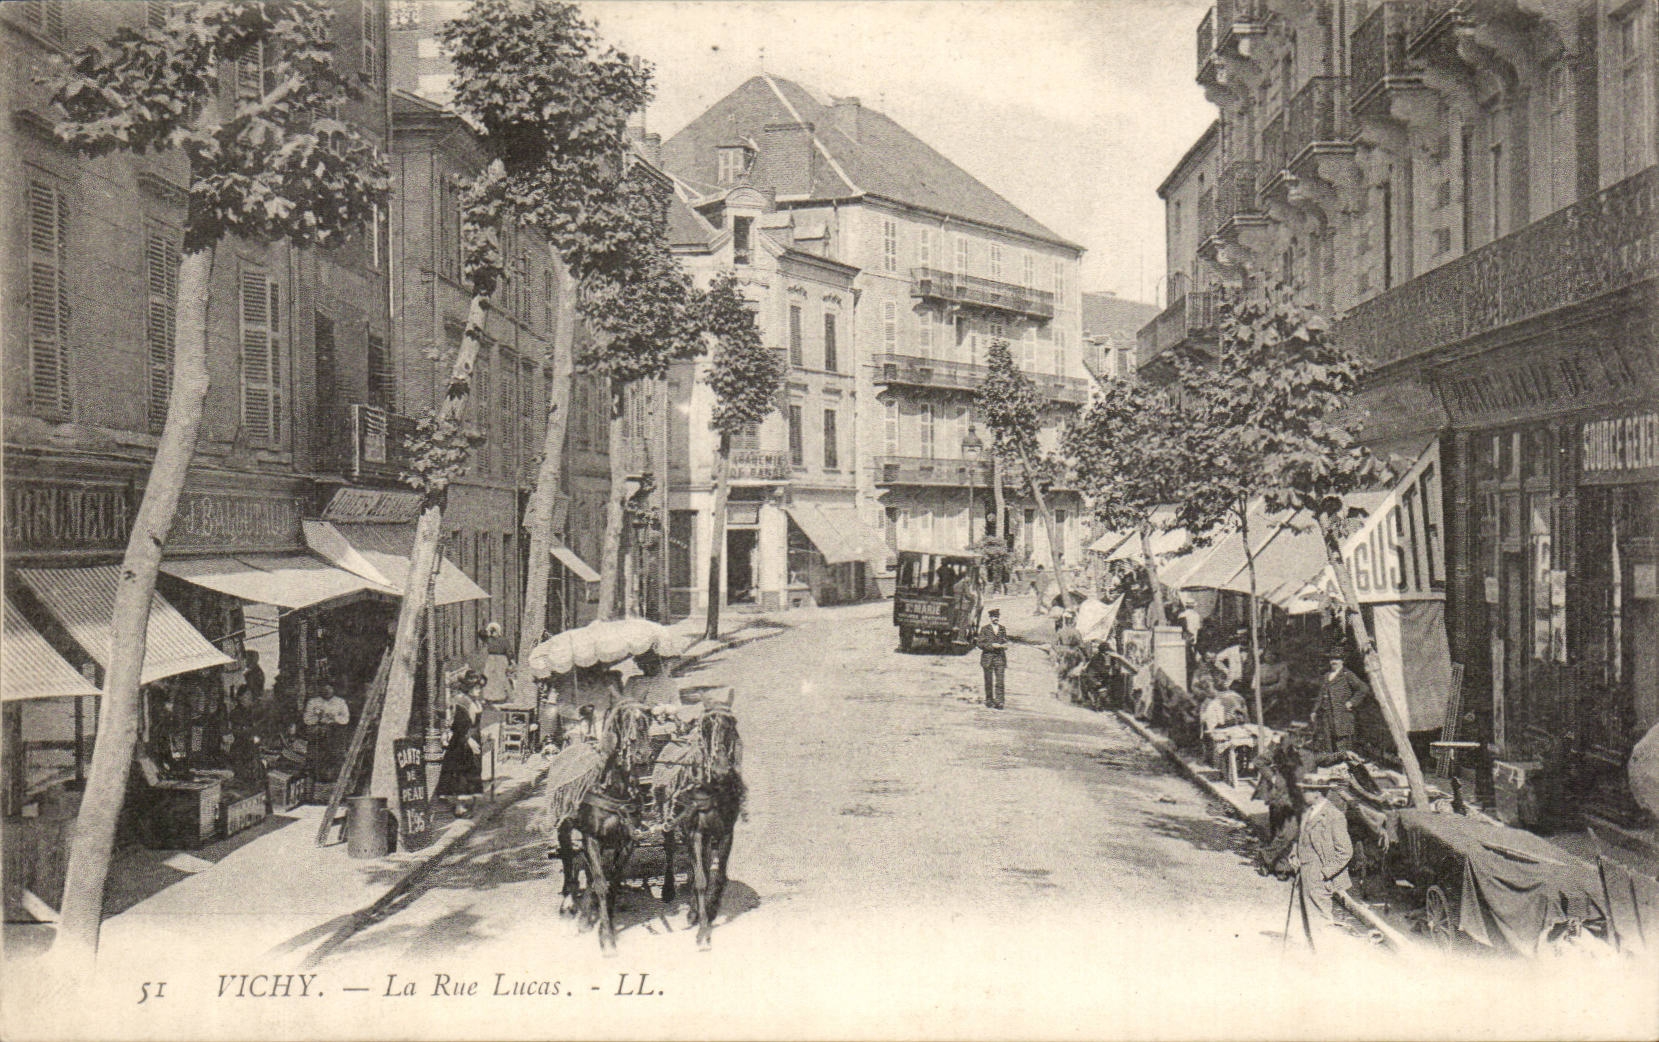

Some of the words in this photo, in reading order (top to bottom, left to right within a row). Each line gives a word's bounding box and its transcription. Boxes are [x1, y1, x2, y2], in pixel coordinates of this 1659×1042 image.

[1583, 418, 1622, 471] SOURCE
[733, 454, 784, 465] ACADEMIE
[1326, 461, 1445, 594] AGUSTE
[914, 603, 941, 615] MARIE
[397, 748, 421, 768] GANTS
[406, 770, 417, 781] DE
[402, 786, 425, 802] PEAU
